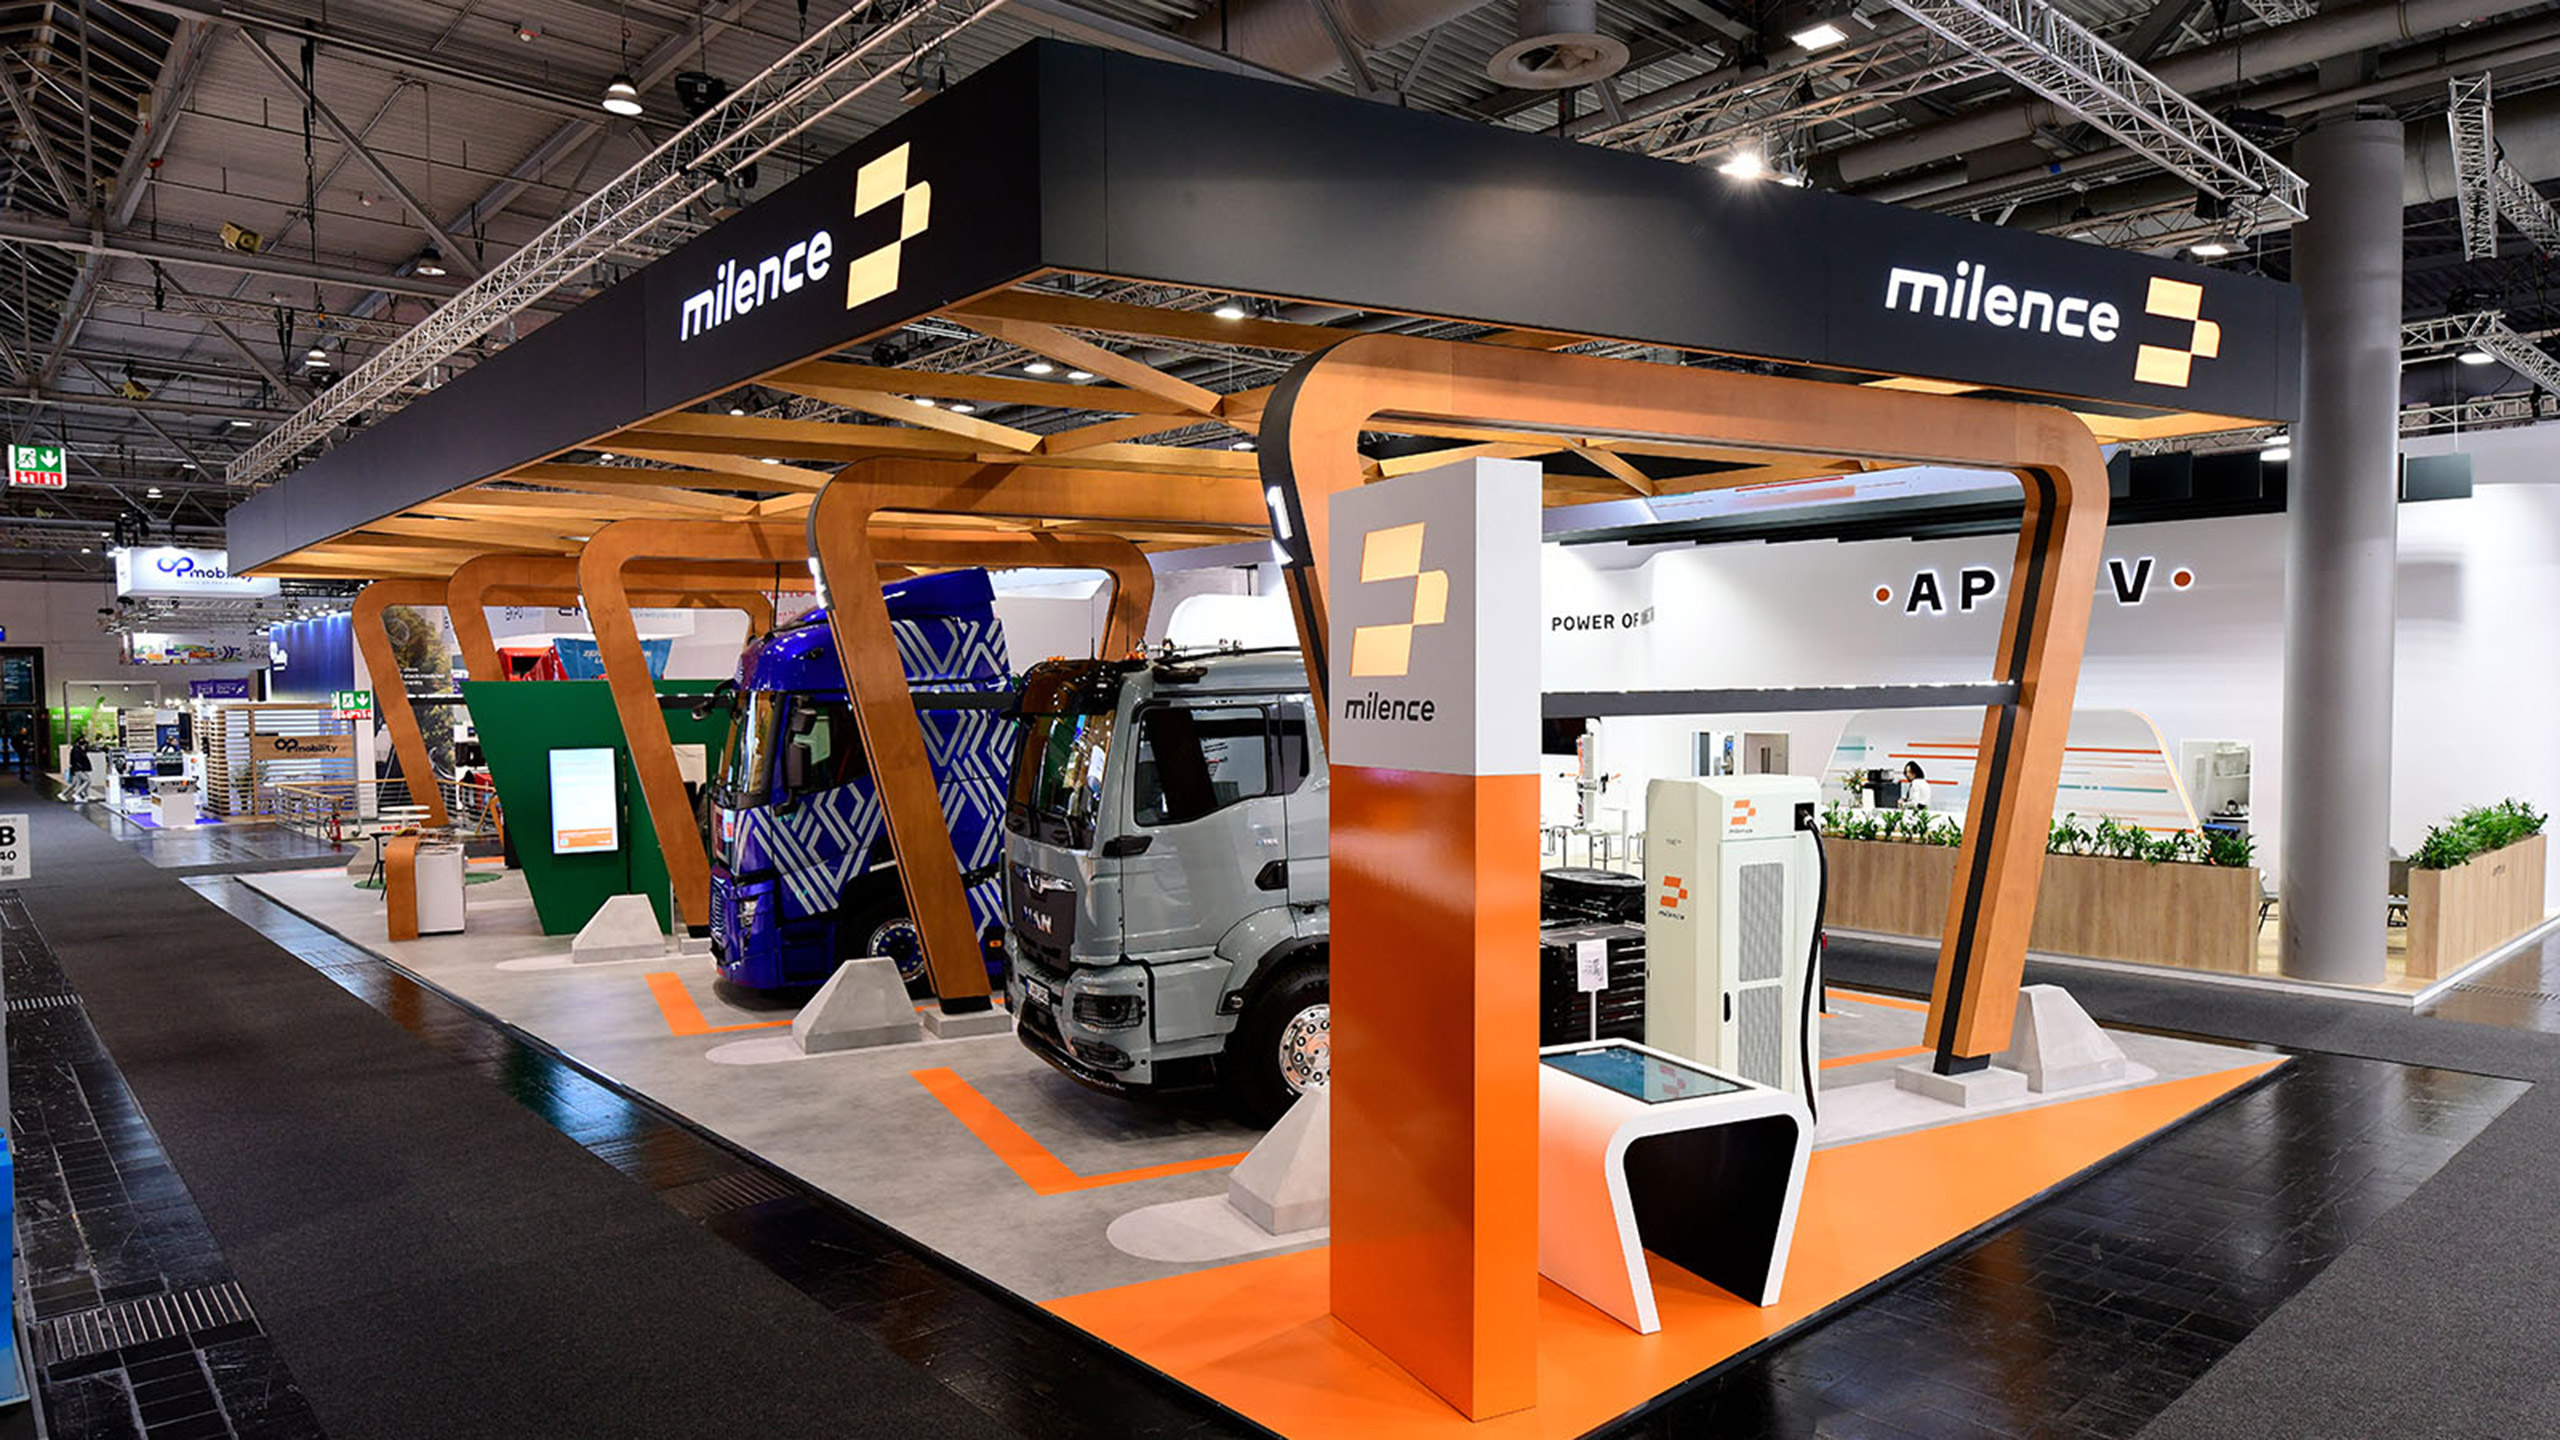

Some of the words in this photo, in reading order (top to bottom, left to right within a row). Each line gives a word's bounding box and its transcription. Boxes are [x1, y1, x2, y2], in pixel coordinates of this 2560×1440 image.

[680, 230, 833, 342] milence
[1885, 260, 2120, 343] milence
[1905, 559, 2153, 613] APV
[1551, 614, 1615, 631] POWER
[1621, 612, 1639, 629] OF
[1344, 691, 1435, 721] milence
[0, 825, 17, 847] B
